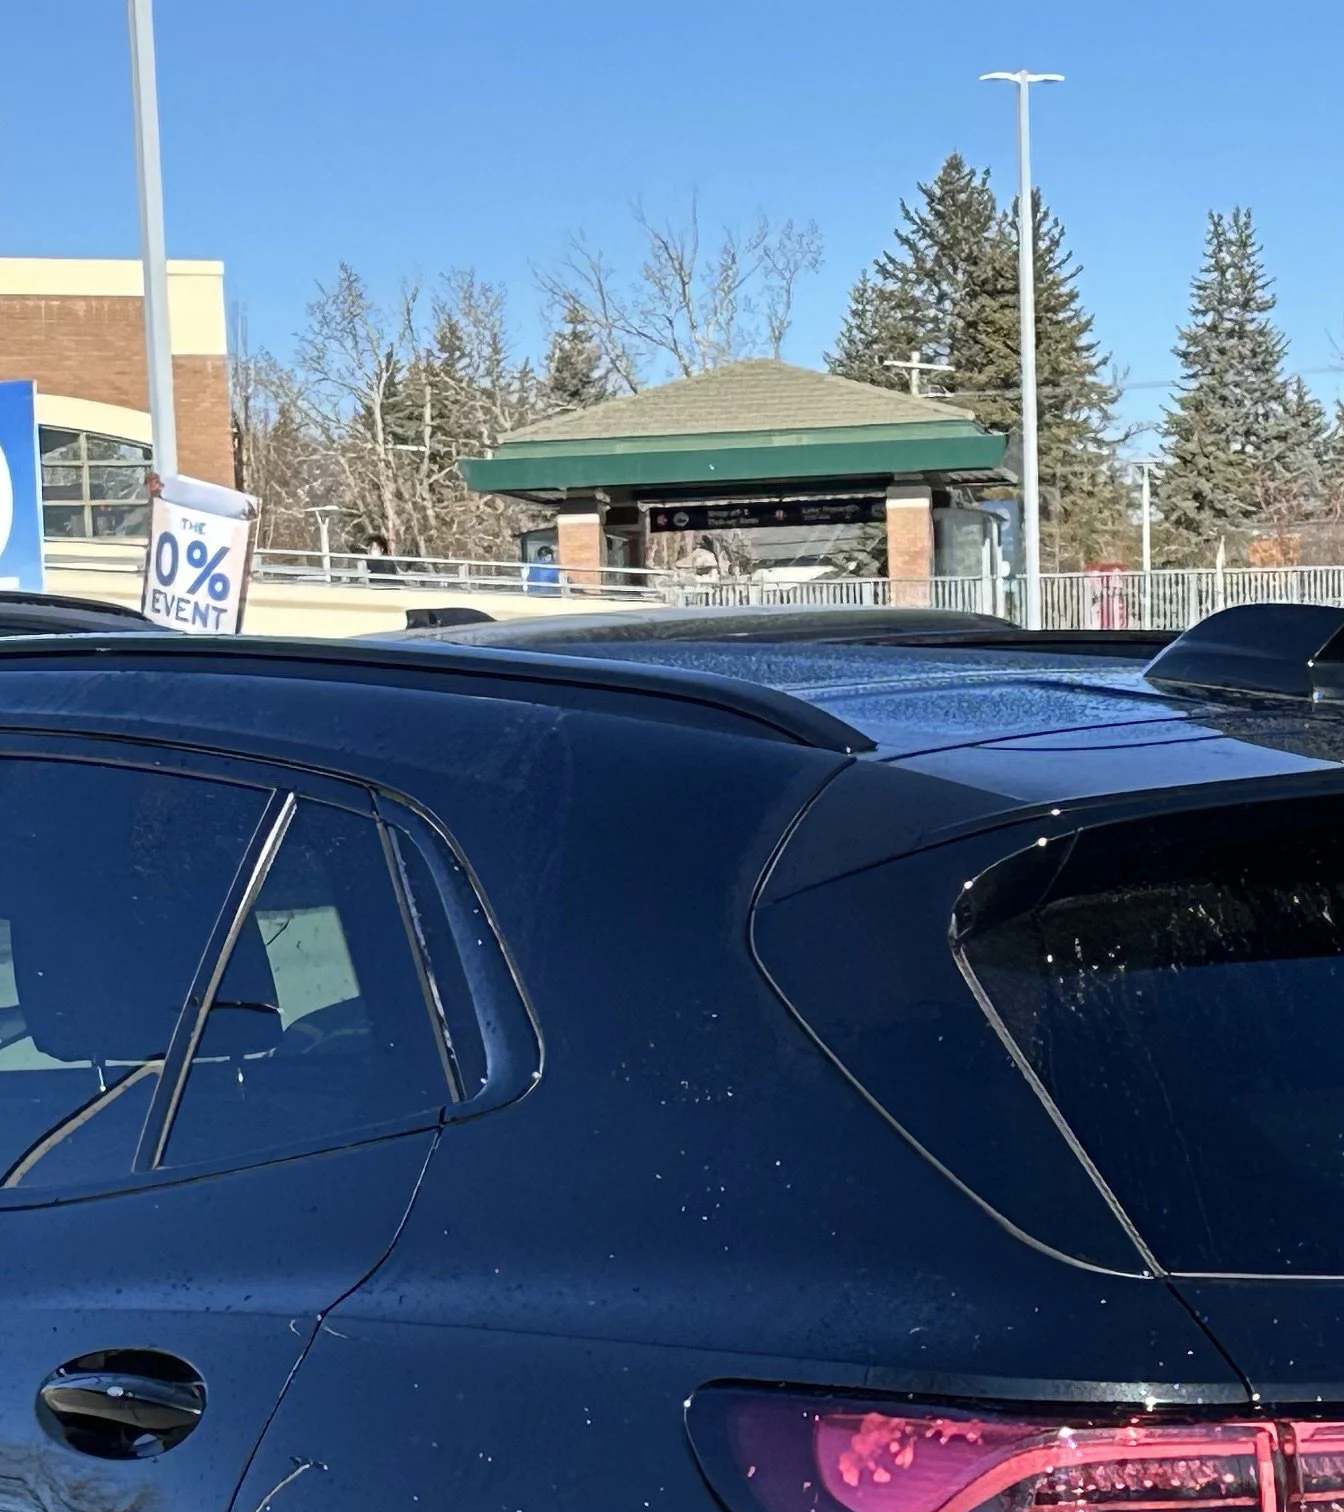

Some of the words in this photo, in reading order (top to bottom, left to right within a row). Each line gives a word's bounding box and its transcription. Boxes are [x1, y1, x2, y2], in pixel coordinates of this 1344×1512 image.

[180, 518, 207, 535] THE
[155, 531, 231, 601] 0%
[151, 588, 228, 631] EVENT
